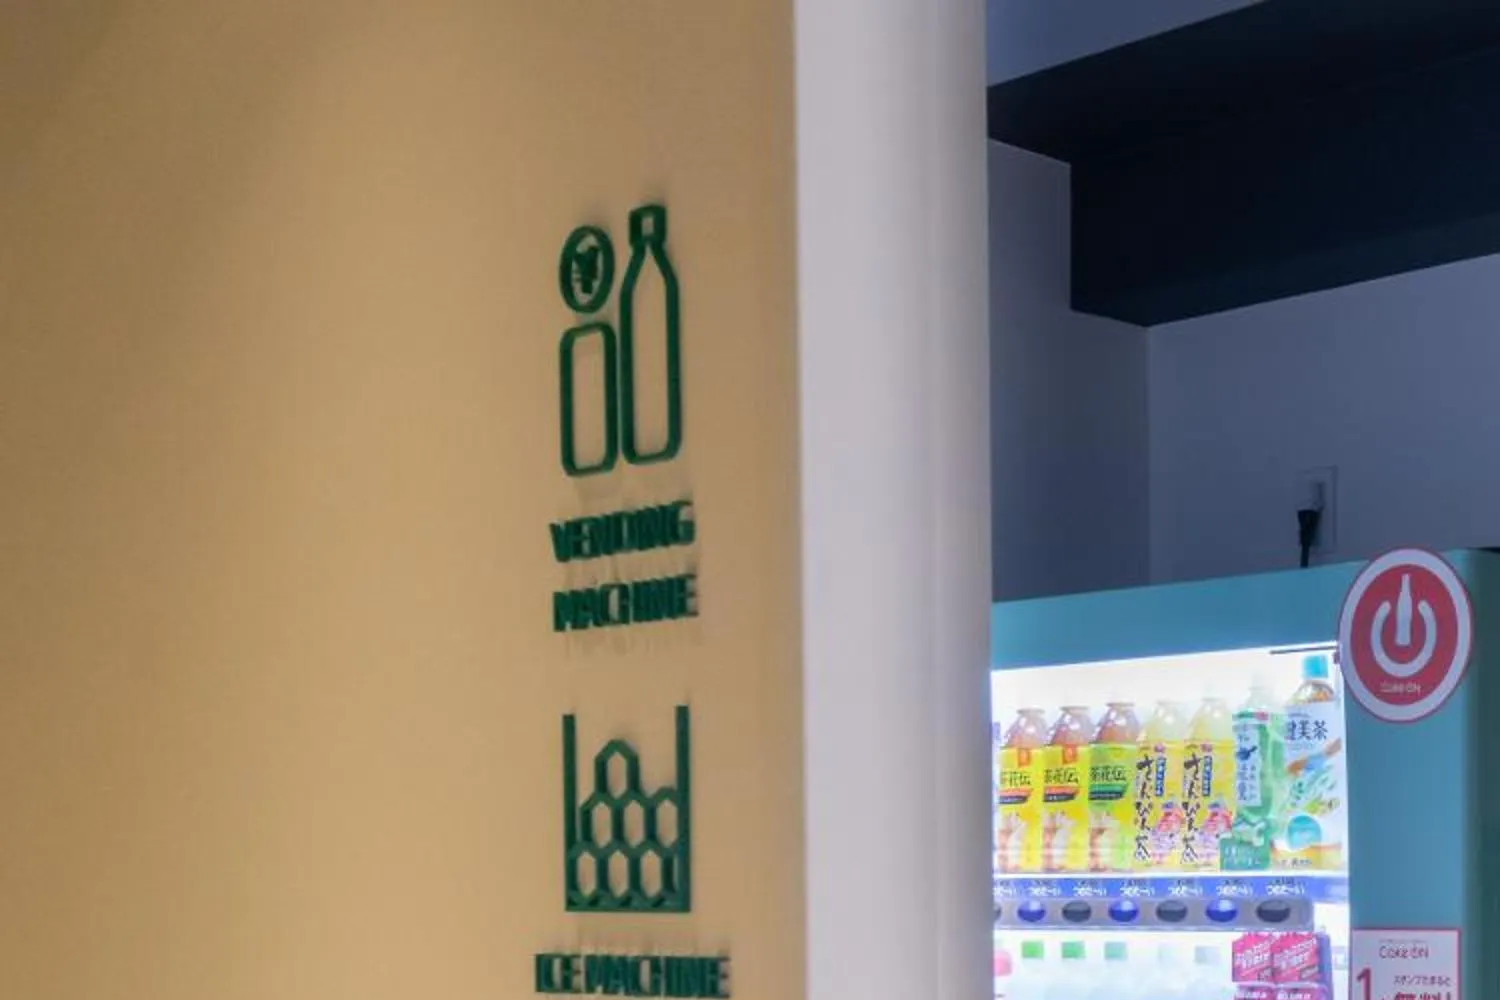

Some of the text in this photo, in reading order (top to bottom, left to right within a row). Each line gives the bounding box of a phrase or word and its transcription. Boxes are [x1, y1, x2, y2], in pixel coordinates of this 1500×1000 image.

[549, 498, 696, 562] VENDING
[553, 572, 699, 632] MACHINE
[535, 953, 730, 1000] ICE MACHINE
